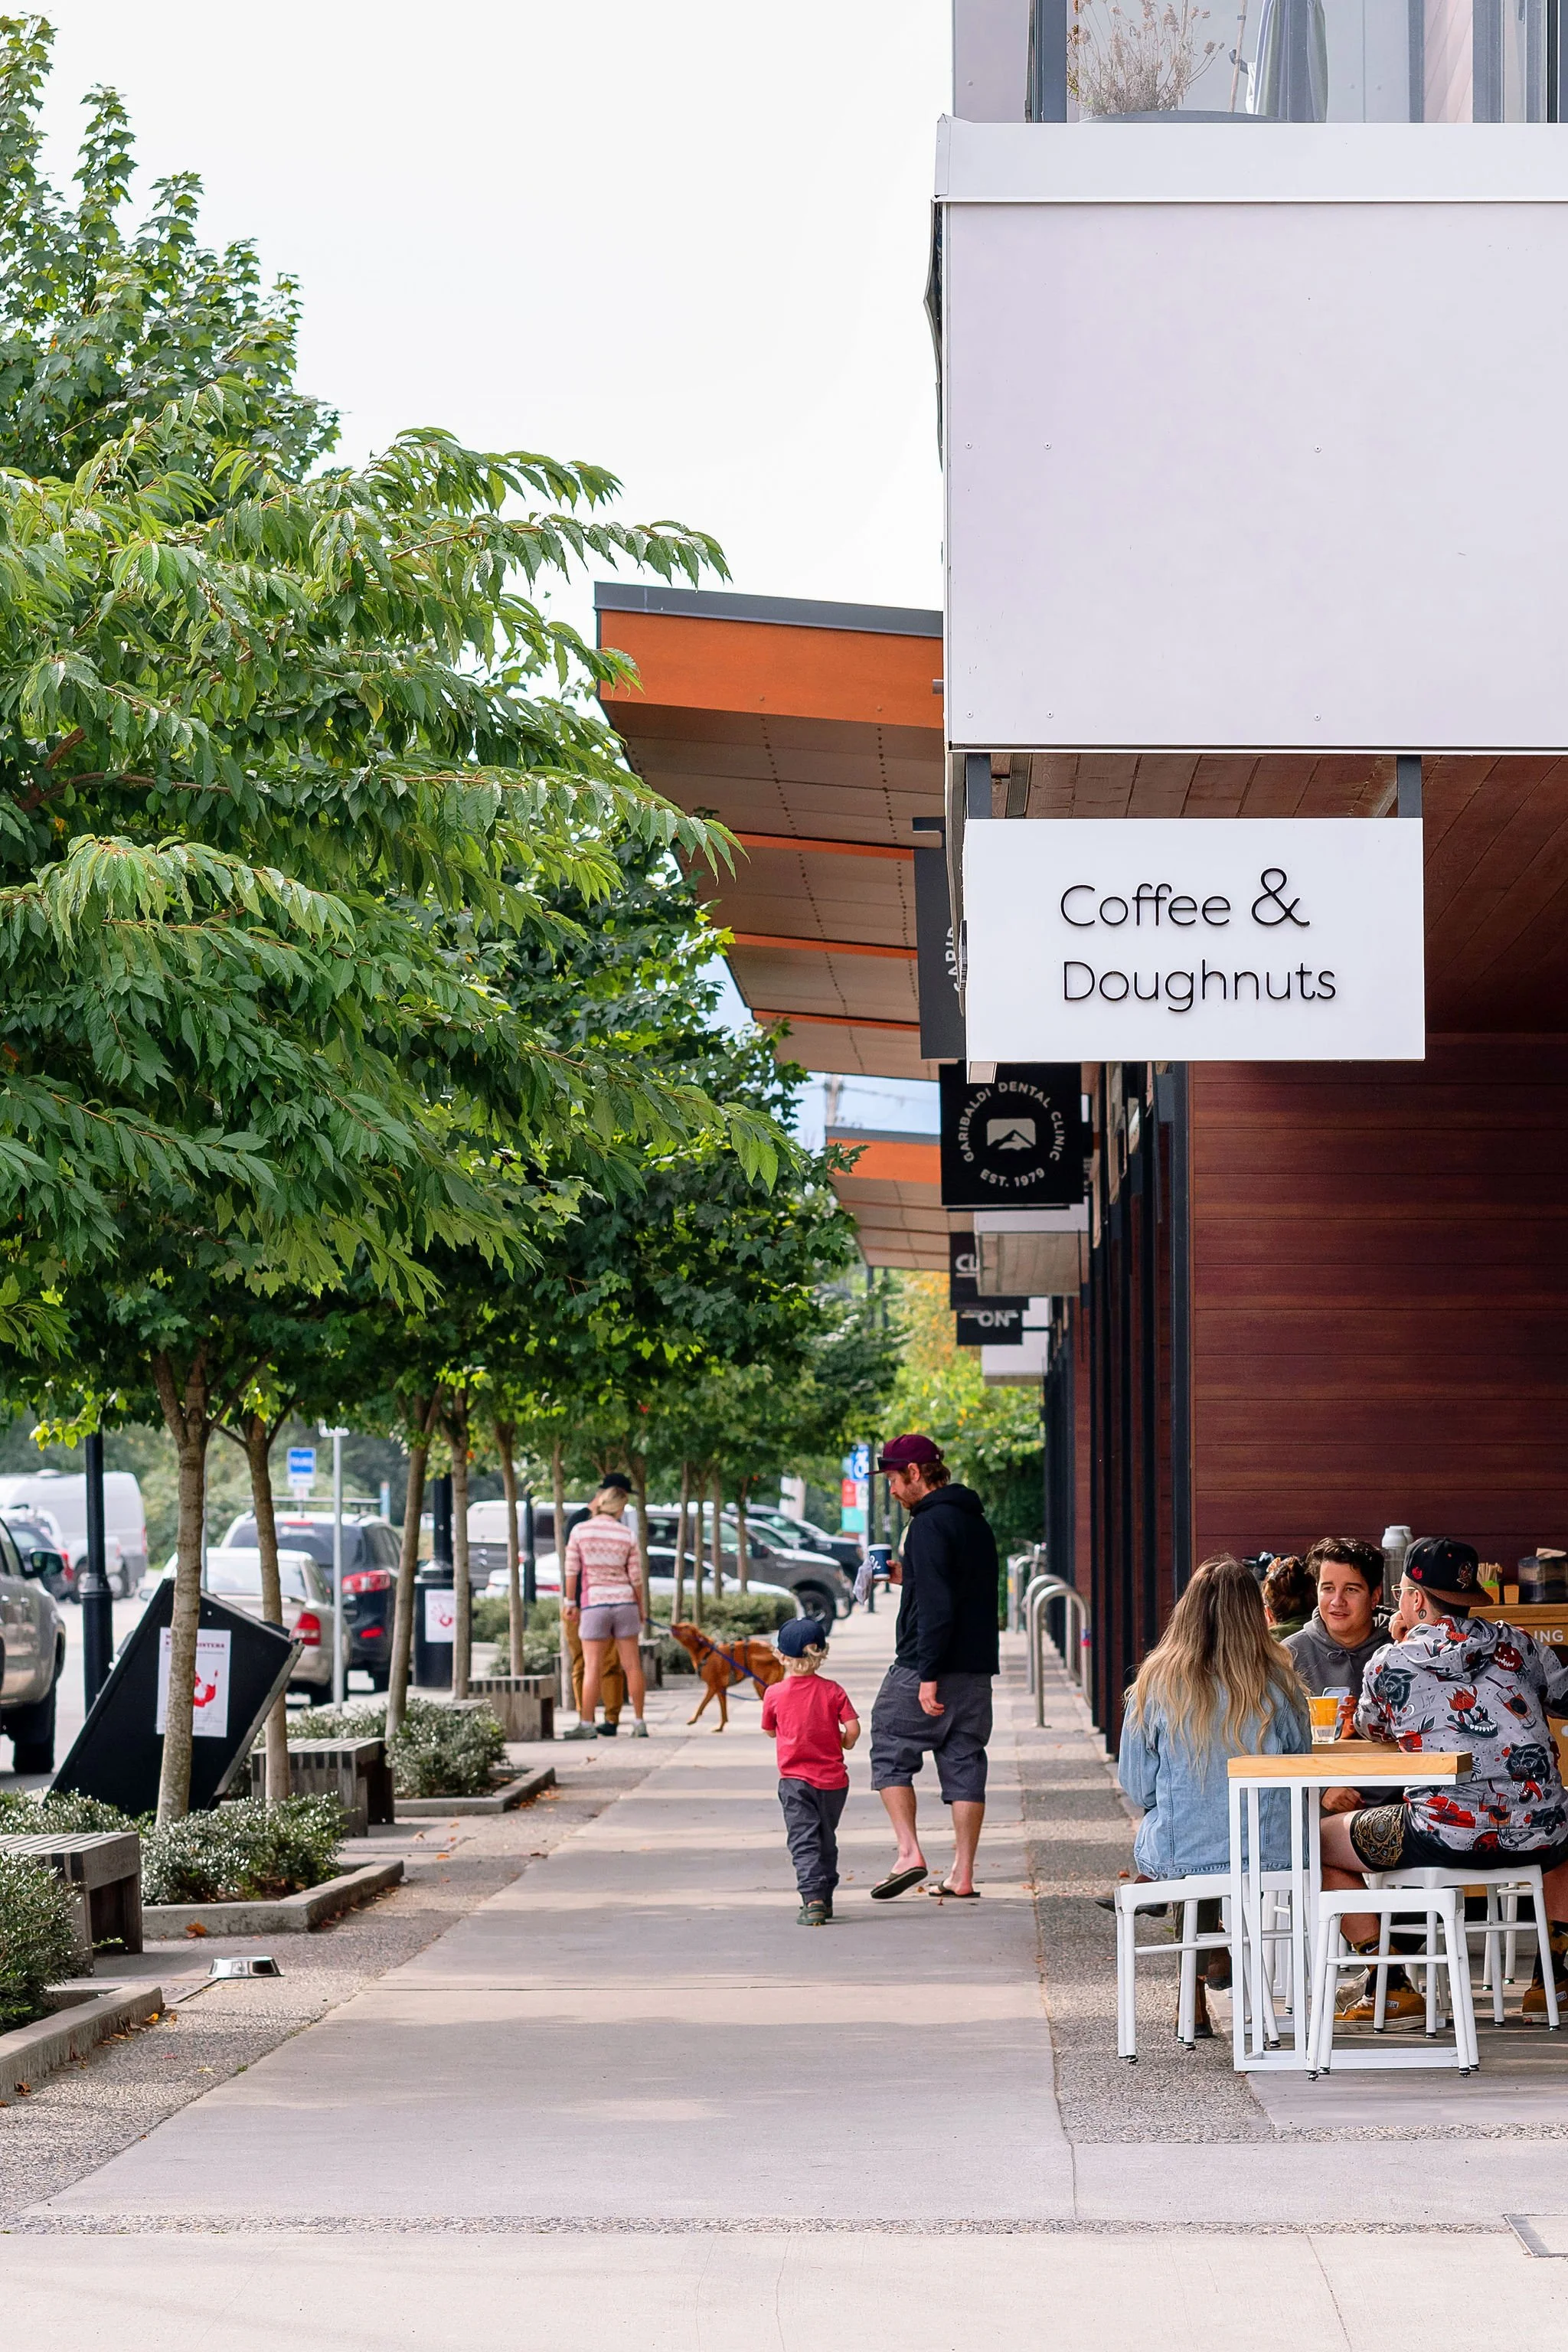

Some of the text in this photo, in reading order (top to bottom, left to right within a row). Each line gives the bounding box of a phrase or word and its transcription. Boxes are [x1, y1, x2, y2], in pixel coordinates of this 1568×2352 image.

[1061, 867, 1310, 927] Coffee &
[1063, 959, 1336, 1013] Doughnuts
[959, 1081, 1065, 1162] GARIBALDI DENTAL CLINIC
[980, 1168, 1045, 1187] EST. 1979
